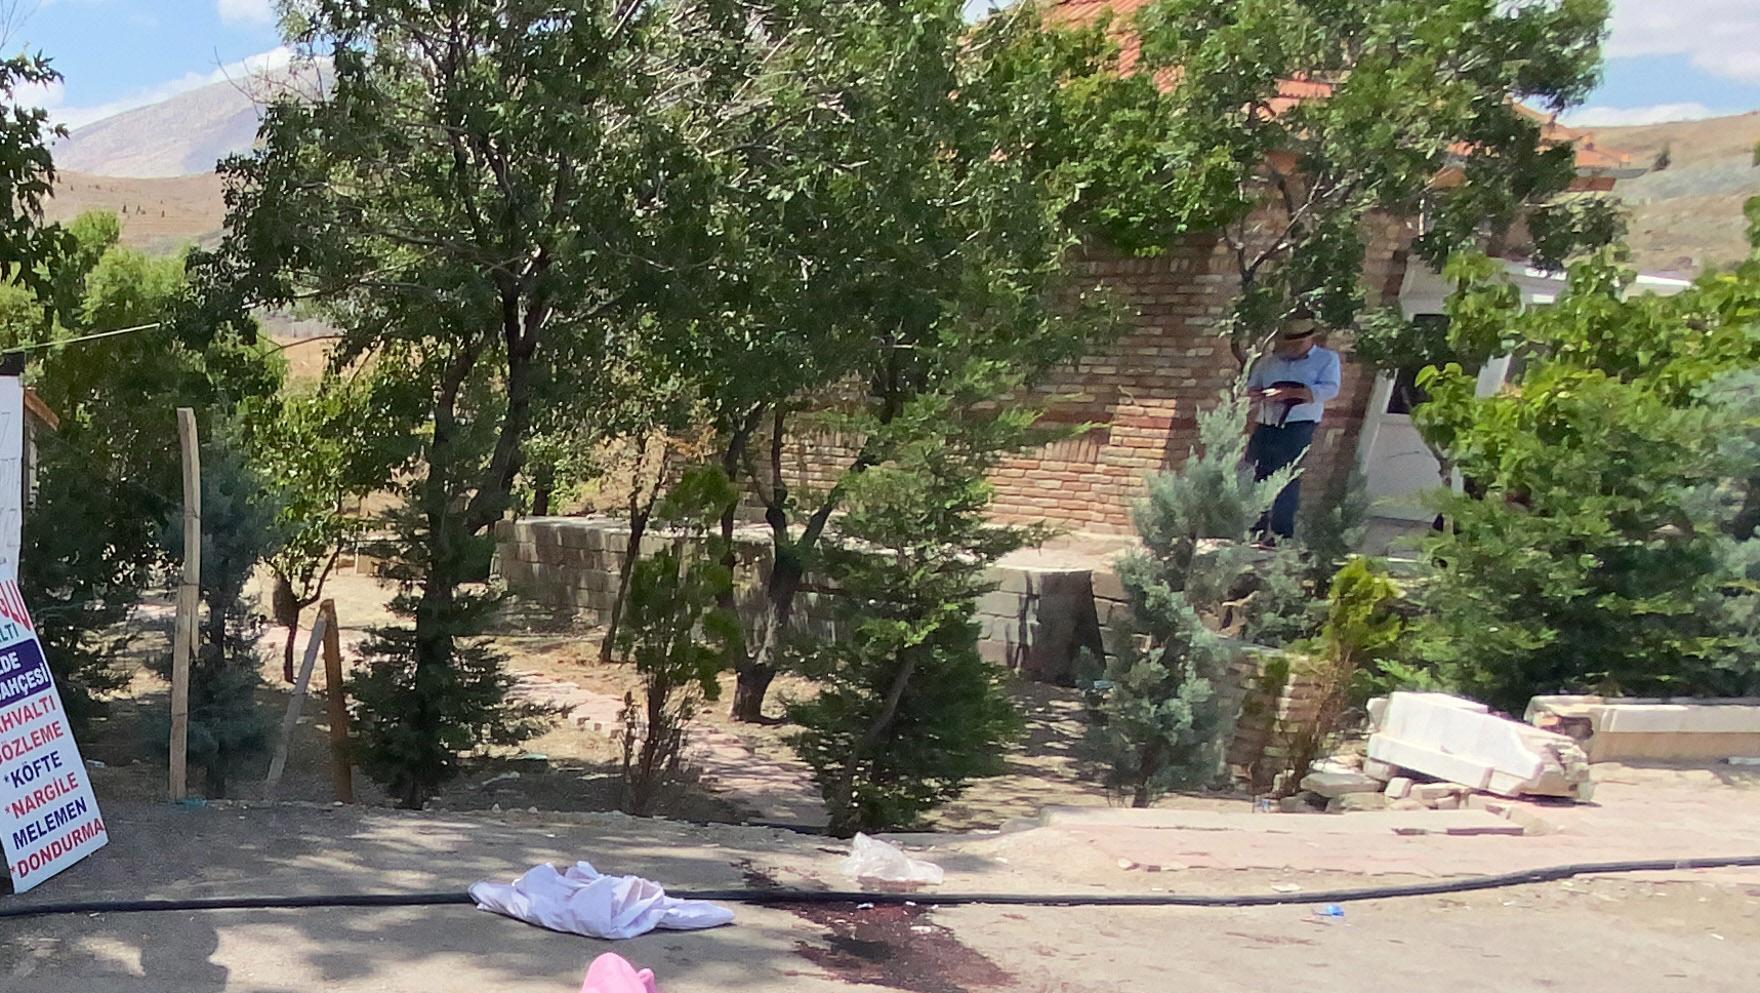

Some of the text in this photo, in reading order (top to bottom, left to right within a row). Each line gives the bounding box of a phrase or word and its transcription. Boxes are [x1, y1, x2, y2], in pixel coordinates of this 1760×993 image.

[10, 750, 63, 788] KÖFTE
[11, 772, 79, 819] NARGİLE
[12, 796, 87, 850] MELEMEN
[18, 818, 105, 878] DONDURMA
